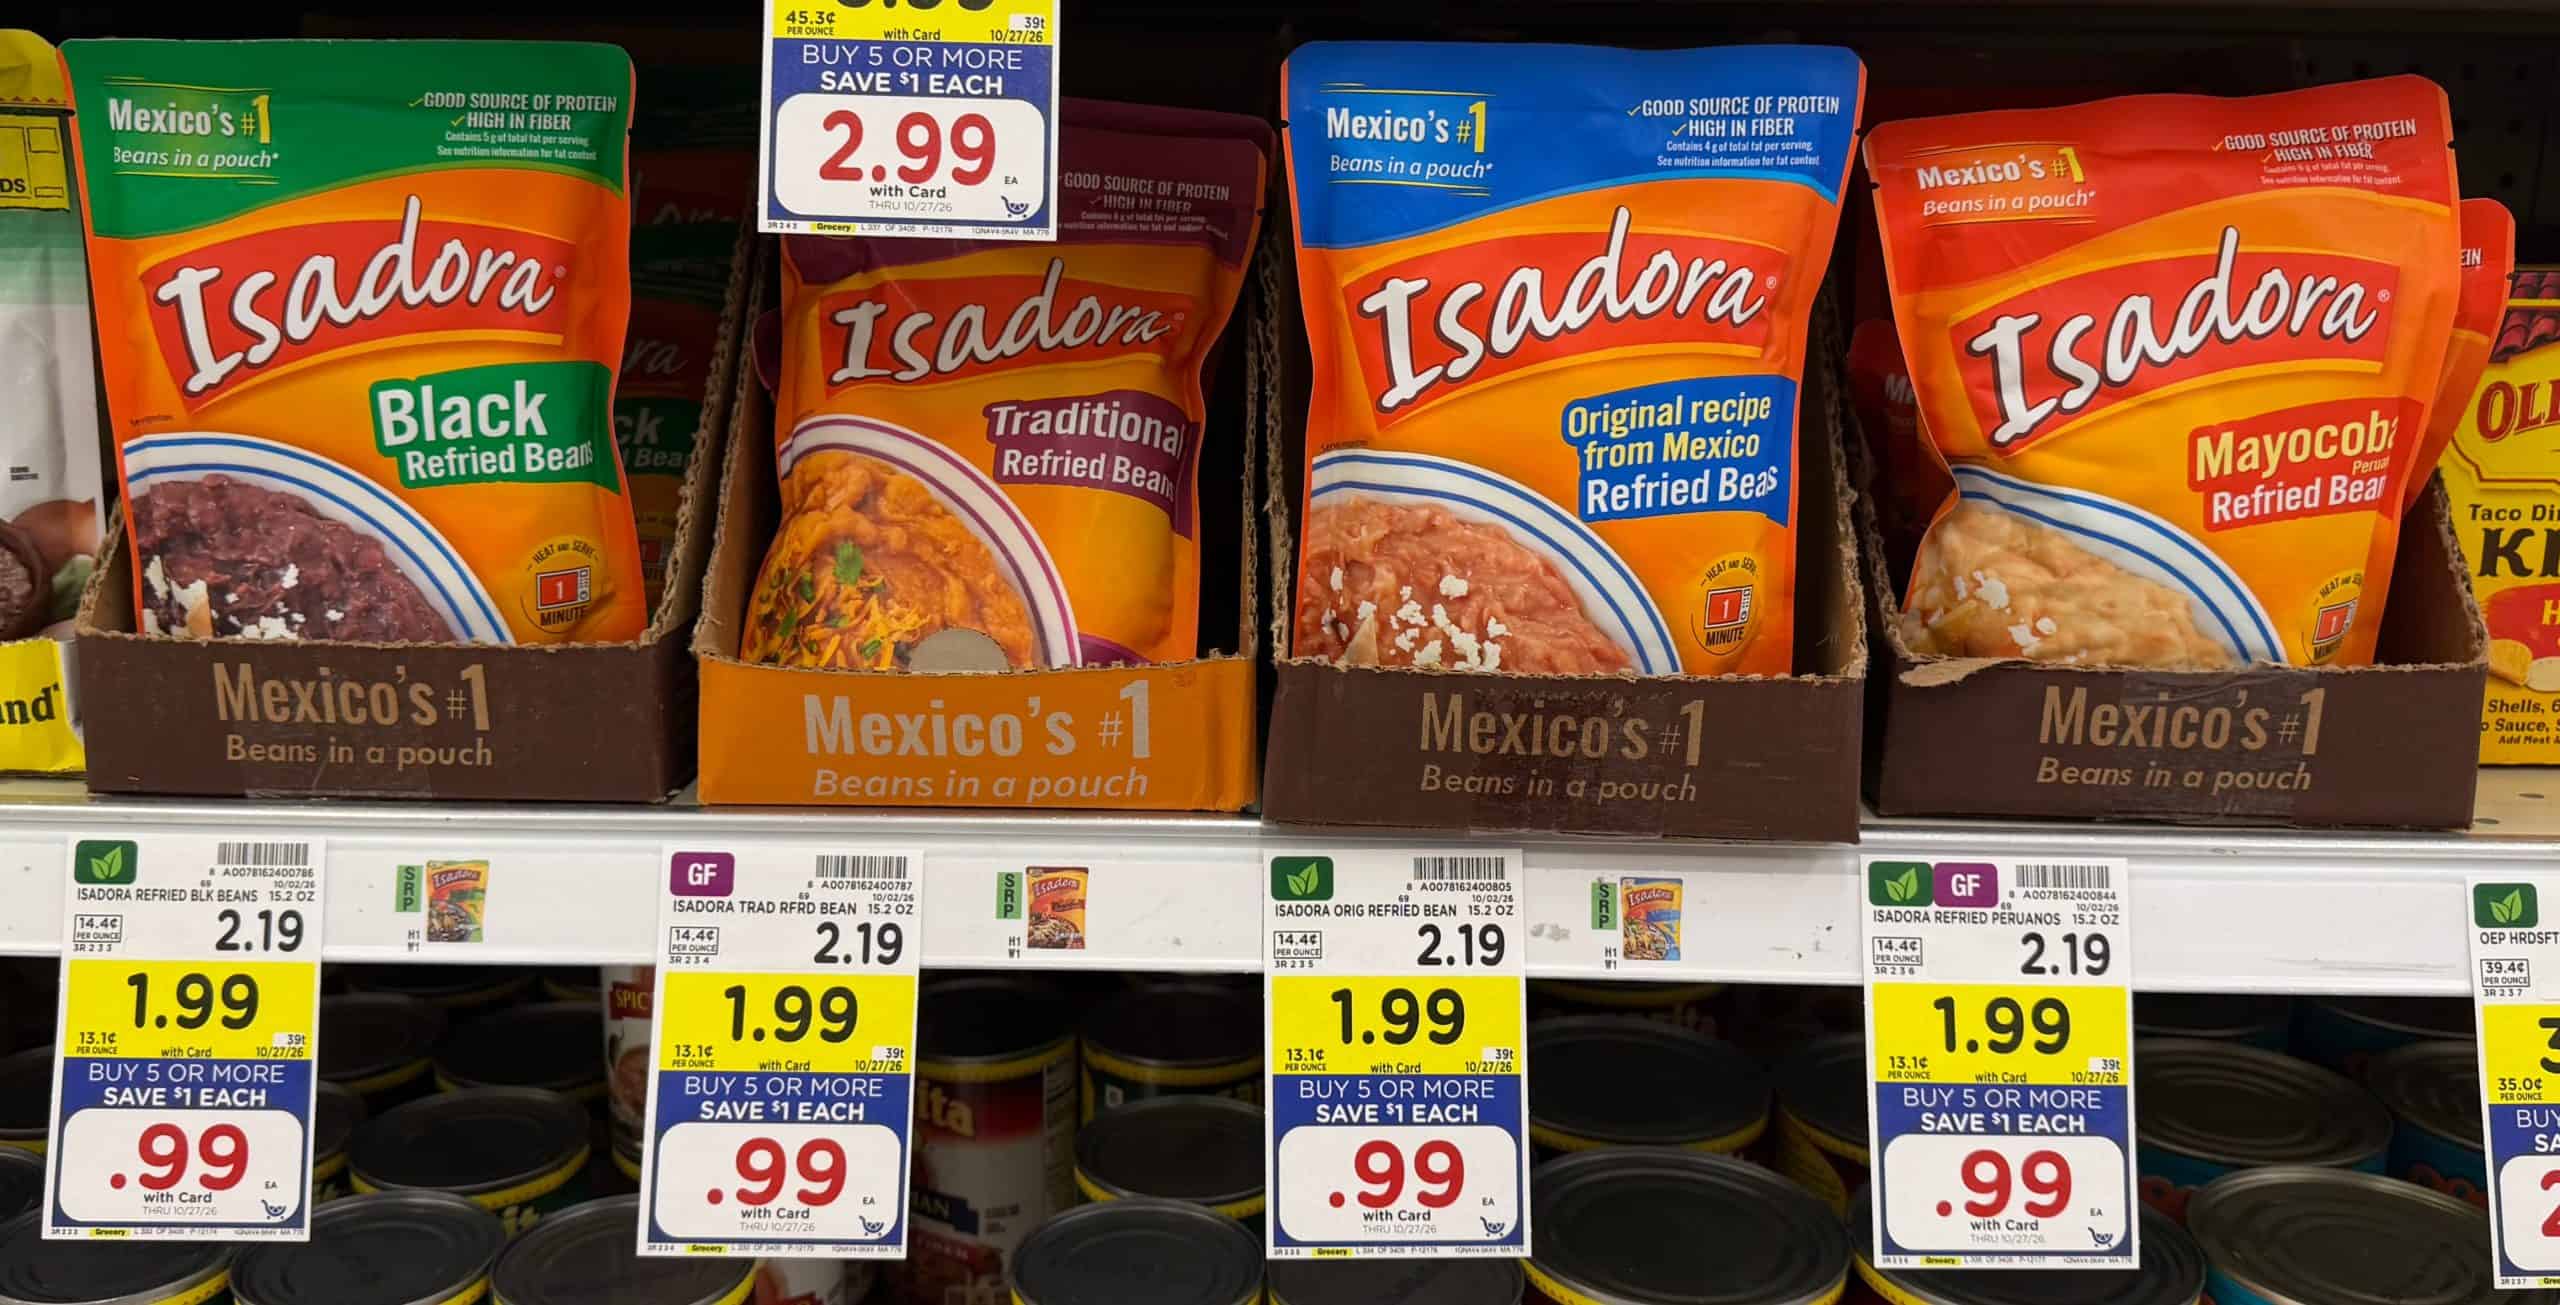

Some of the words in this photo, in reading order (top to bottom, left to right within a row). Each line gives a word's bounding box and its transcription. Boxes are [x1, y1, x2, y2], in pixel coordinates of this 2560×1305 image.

[786, 11, 836, 24] 45.3¢
[786, 26, 802, 34] PER
[805, 27, 834, 36] OUNCE
[884, 30, 909, 40] with
[912, 30, 940, 41] Card
[990, 30, 1043, 42] 10/27/26
[803, 45, 859, 65] BUY
[869, 46, 883, 66] 5
[893, 46, 933, 67] OR
[943, 47, 1022, 70] MORE
[820, 71, 891, 93] SAVE
[900, 71, 920, 94] $1
[929, 74, 1002, 95] EACH
[423, 92, 465, 108] GOOD
[470, 93, 529, 110] SOURCE
[533, 95, 552, 110] OF
[556, 95, 617, 112] PROTEIN
[1642, 100, 1684, 116] GOOD
[1690, 97, 1749, 115] SOURCE
[1754, 97, 1773, 114] OF
[1778, 96, 1839, 114] PROTEIN
[109, 98, 235, 136] Mexico's
[241, 95, 271, 143] #1
[467, 112, 504, 128] HIGH
[510, 114, 524, 128] IN
[530, 115, 570, 130] FIBER
[1327, 107, 1449, 143] Mexico's
[1457, 101, 1486, 152] #1
[1689, 120, 1726, 136] HIGH
[1731, 120, 1746, 136] IN
[1752, 118, 1794, 135] FIBER
[2224, 134, 2265, 151] GOOD
[2269, 128, 2328, 146] SOURCE
[2332, 127, 2350, 142] OF
[2353, 119, 2416, 140] PROTEIN
[114, 147, 168, 165] Beans
[174, 149, 192, 166] in
[197, 154, 208, 166] a
[818, 109, 996, 186] 2.99
[2274, 148, 2313, 163] HIGH
[2317, 147, 2332, 160] IN
[2337, 142, 2373, 160] FIBER
[1004, 176, 1018, 185] EA
[1331, 154, 1383, 172] Beans
[1388, 156, 1404, 173] in
[1410, 162, 1422, 175] a
[1917, 154, 2045, 189] Mexico's
[2051, 147, 2084, 183] #1
[869, 184, 904, 198] with
[909, 186, 946, 200] Card
[1923, 198, 1983, 216] Beans
[1989, 194, 2005, 210] in
[2012, 196, 2023, 209] a
[156, 195, 555, 394] Isadora
[1362, 206, 1765, 408] Isadora
[829, 258, 1171, 387] Isadora
[1972, 226, 2375, 446] Isadora
[378, 380, 548, 446] Black
[1568, 395, 1683, 438] Original
[1691, 392, 1771, 427] recipe
[405, 443, 516, 481] Refried
[1003, 449, 1107, 480] Refried
[1584, 441, 1653, 471] from
[1663, 429, 1759, 462] Mexico
[1587, 469, 1710, 514] Refried
[2213, 477, 2321, 523] Refried
[2470, 504, 2521, 521] Taco
[1706, 627, 1744, 646] MINUTE
[213, 662, 437, 724] Mexico's
[446, 665, 490, 731] #1
[804, 694, 1075, 757] Mexico's
[1098, 679, 1151, 759] #1
[1420, 693, 1648, 758] Mexico's
[1659, 700, 1704, 765] #1
[2040, 686, 2267, 748] Mexico's
[2279, 688, 2325, 755] #1
[226, 735, 316, 764] Beans
[329, 738, 354, 763] in
[367, 743, 385, 764] a
[398, 737, 493, 769] pouch
[814, 769, 934, 797] Beans
[947, 770, 979, 796] in
[993, 777, 1015, 798] a
[1027, 767, 1148, 802] pouch
[688, 863, 717, 885] GF
[1952, 874, 1980, 896] GF
[78, 888, 132, 900] ISADORA
[136, 889, 187, 901] REFRIED
[191, 889, 214, 901] BLK
[217, 890, 258, 901] BEANS
[269, 891, 293, 901] 15.2
[297, 891, 315, 901] OZ
[673, 901, 734, 913] ISADORA
[740, 901, 775, 913] TRAD
[780, 902, 815, 914] RFRD
[820, 903, 857, 915] BEAN
[868, 904, 892, 915] 15.2
[895, 905, 914, 915] OZ
[1275, 904, 1330, 916] ISADORA
[1334, 905, 1364, 917] ORIG
[1368, 904, 1419, 917] REFRIED
[1424, 905, 1456, 916] BEAN
[1468, 905, 1492, 915] 15.2
[1496, 905, 1513, 915] OZ
[80, 917, 118, 929] 14.4¢
[216, 909, 303, 951] 2.19
[1873, 911, 1930, 922] ISADORA
[1935, 912, 1988, 924] REFRIED
[1992, 913, 2061, 925] PERUANOS
[2072, 914, 2096, 924] 15.2
[2101, 914, 2119, 925] OZ
[814, 922, 902, 965] 2.19
[1417, 924, 1505, 966] 2.19
[2480, 932, 2506, 944] OEP
[2021, 933, 2110, 976] 2.19
[2486, 962, 2524, 973] 39.4¢
[127, 973, 258, 1029] 1.99
[725, 985, 857, 1042] 1.99
[1332, 988, 1464, 1044] 1.99
[80, 1032, 116, 1044] 13.1¢
[1934, 997, 2070, 1054] 1.99
[89, 1064, 139, 1081] BUY
[147, 1064, 160, 1082] 5
[168, 1064, 204, 1082] OR
[213, 1065, 285, 1083] MORE
[2498, 1078, 2542, 1091] 35.0¢
[104, 1088, 166, 1106] SAVE
[174, 1087, 190, 1106] $1
[200, 1089, 266, 1107] EACH
[110, 1123, 248, 1190] .99
[707, 1137, 847, 1206] .99
[1329, 1140, 1464, 1208] .99
[1937, 1150, 2072, 1218] .99
